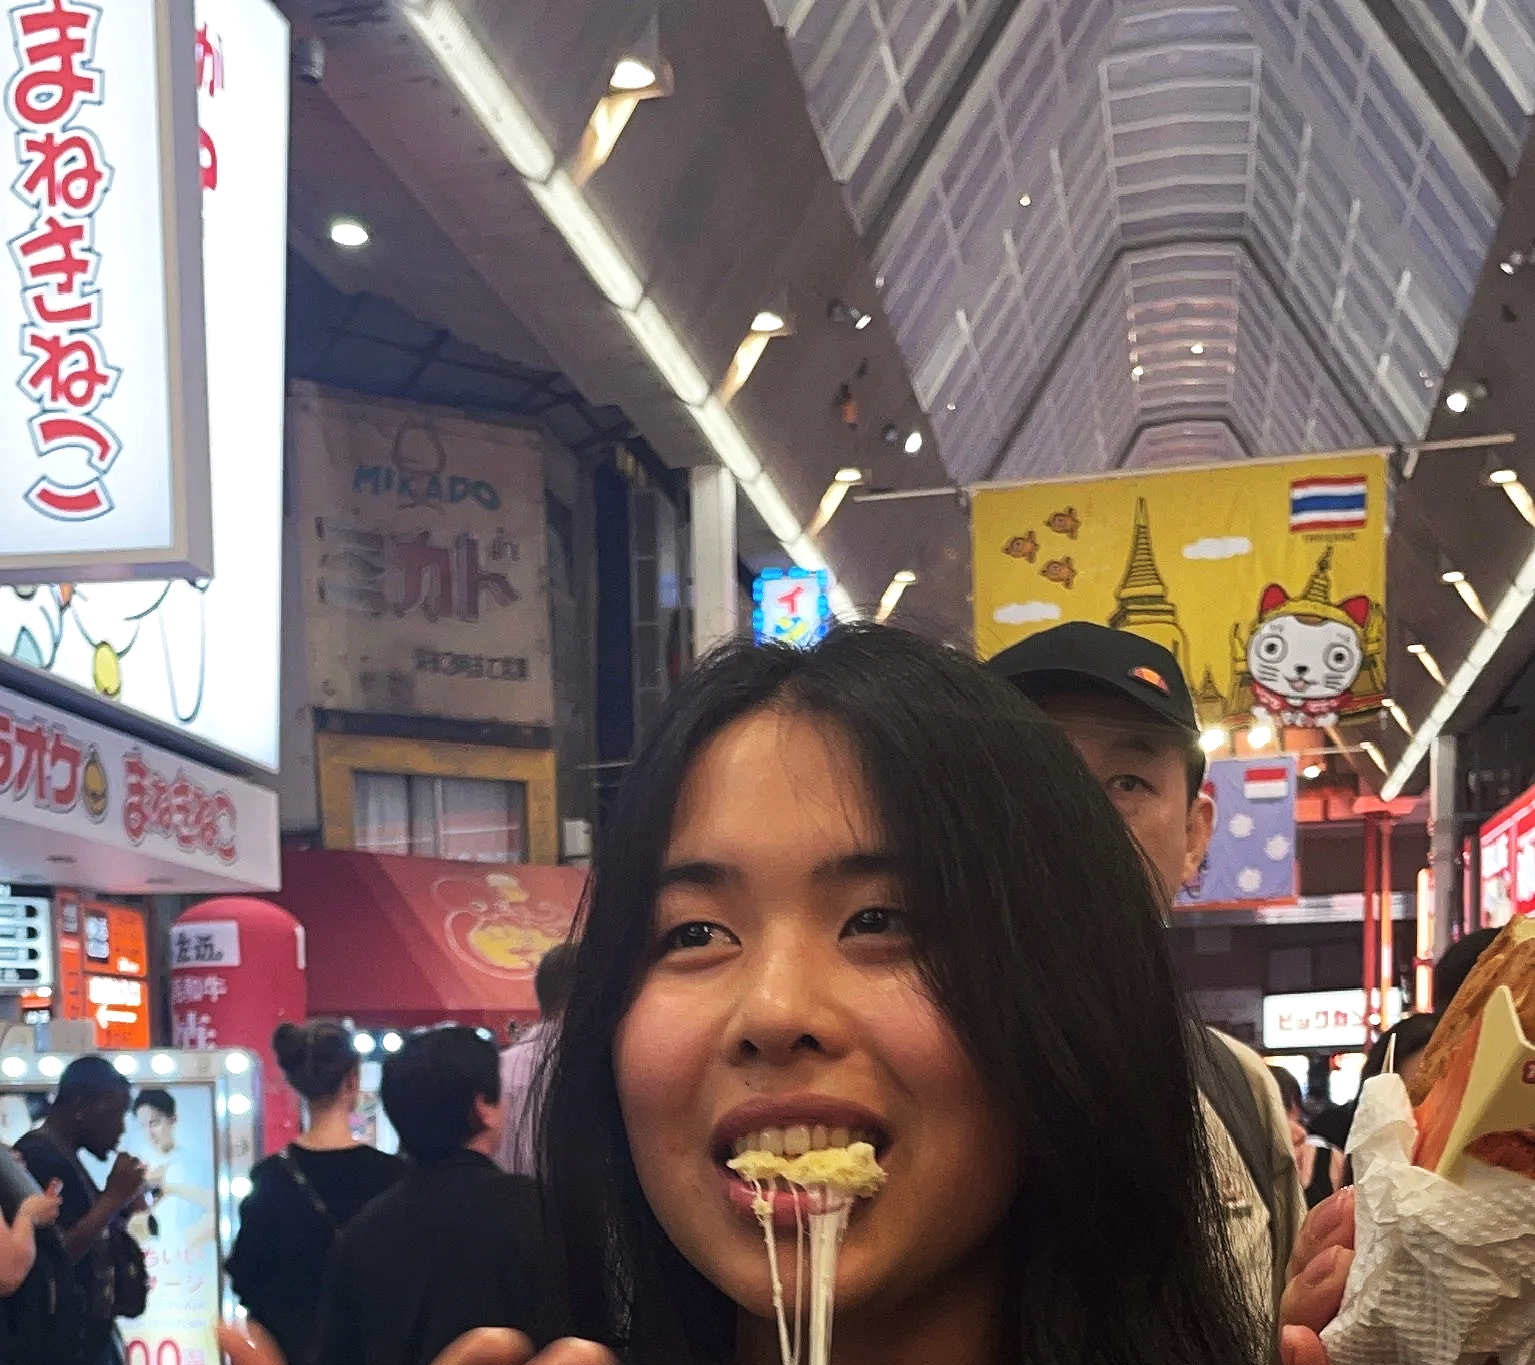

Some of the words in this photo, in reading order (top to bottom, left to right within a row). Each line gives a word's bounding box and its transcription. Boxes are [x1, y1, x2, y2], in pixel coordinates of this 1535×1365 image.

[10, 0, 116, 516] まねきねこ
[353, 464, 500, 511] MIKADO
[124, 756, 236, 860] まねきねこ
